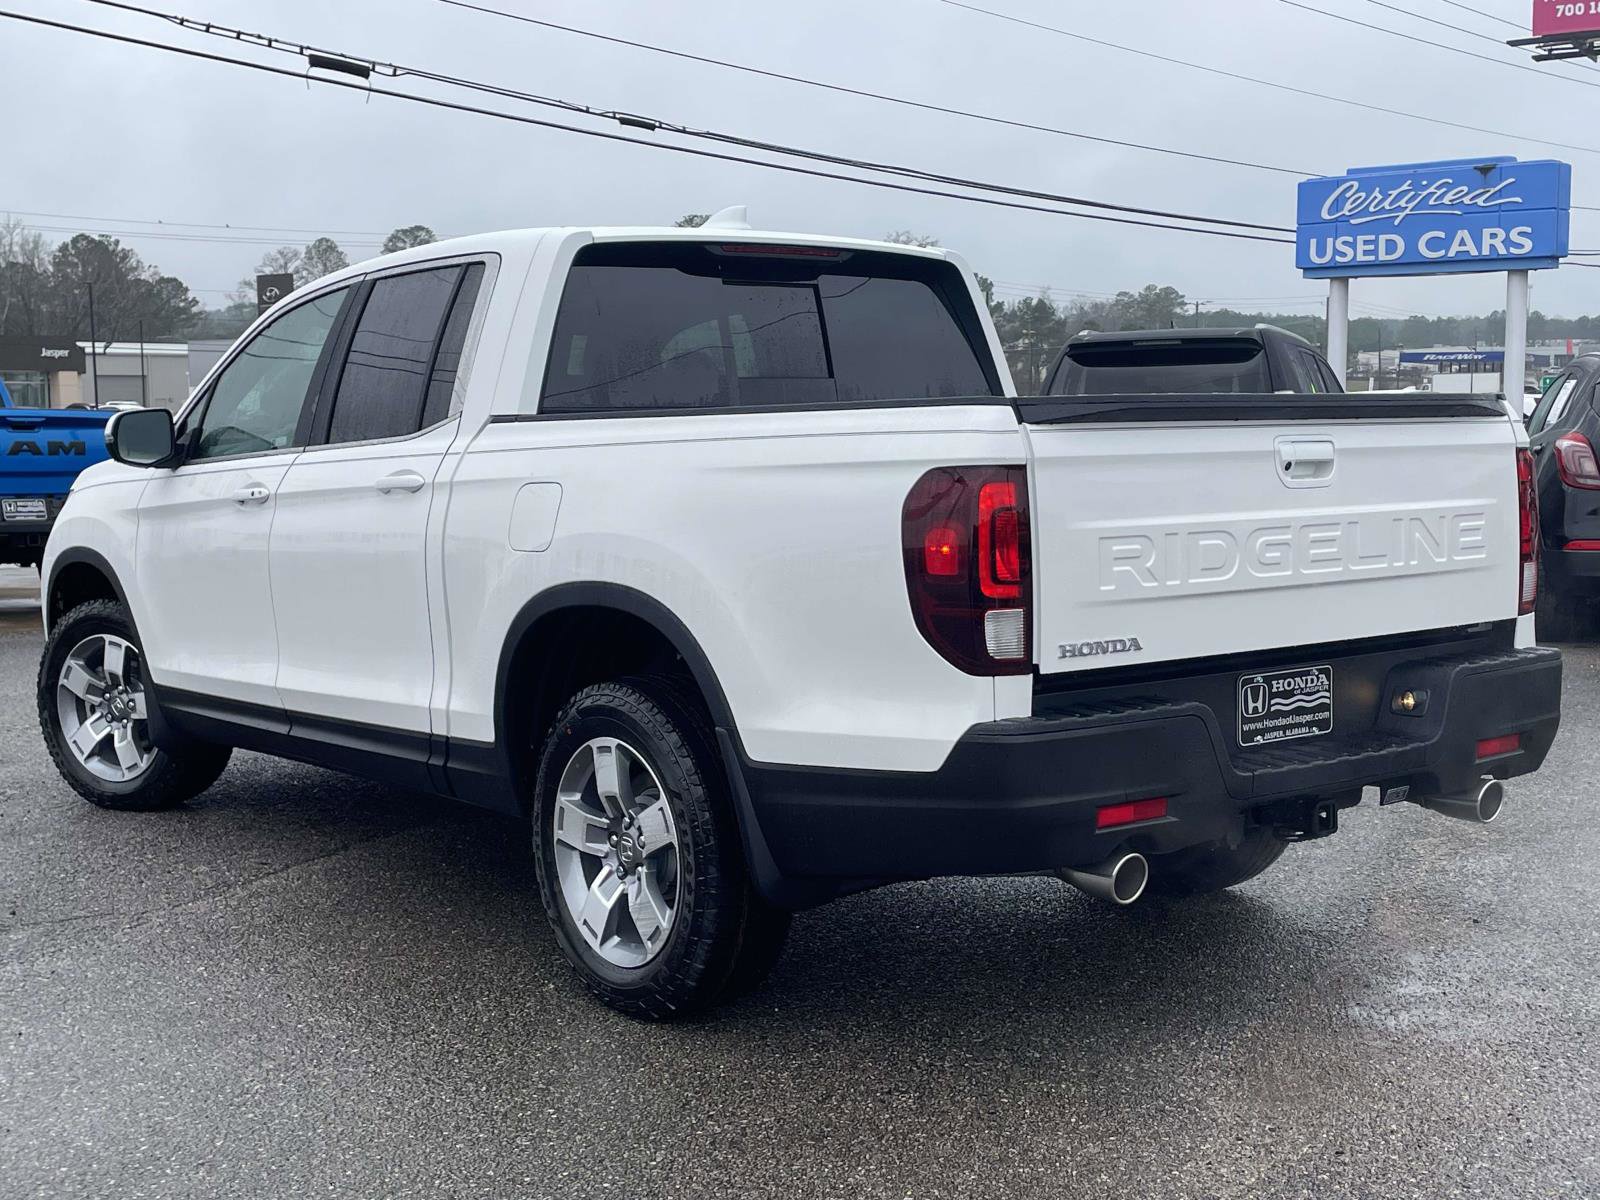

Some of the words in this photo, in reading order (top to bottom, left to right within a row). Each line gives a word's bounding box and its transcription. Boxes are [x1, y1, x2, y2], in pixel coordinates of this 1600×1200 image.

[1555, 3, 1585, 18] 700
[1589, 1, 1600, 15] 1
[1320, 178, 1523, 226] Certified
[1309, 234, 1406, 264] USED
[1417, 226, 1534, 259] CARS
[41, 347, 70, 359] Jasper
[7, 441, 87, 456] AM
[1099, 511, 1487, 591] RIDGELINE
[1057, 638, 1143, 660] HONDA
[1271, 674, 1329, 693] HONDA
[1301, 685, 1329, 693] JASPER
[1242, 711, 1330, 731] www.HondaofJasper.com
